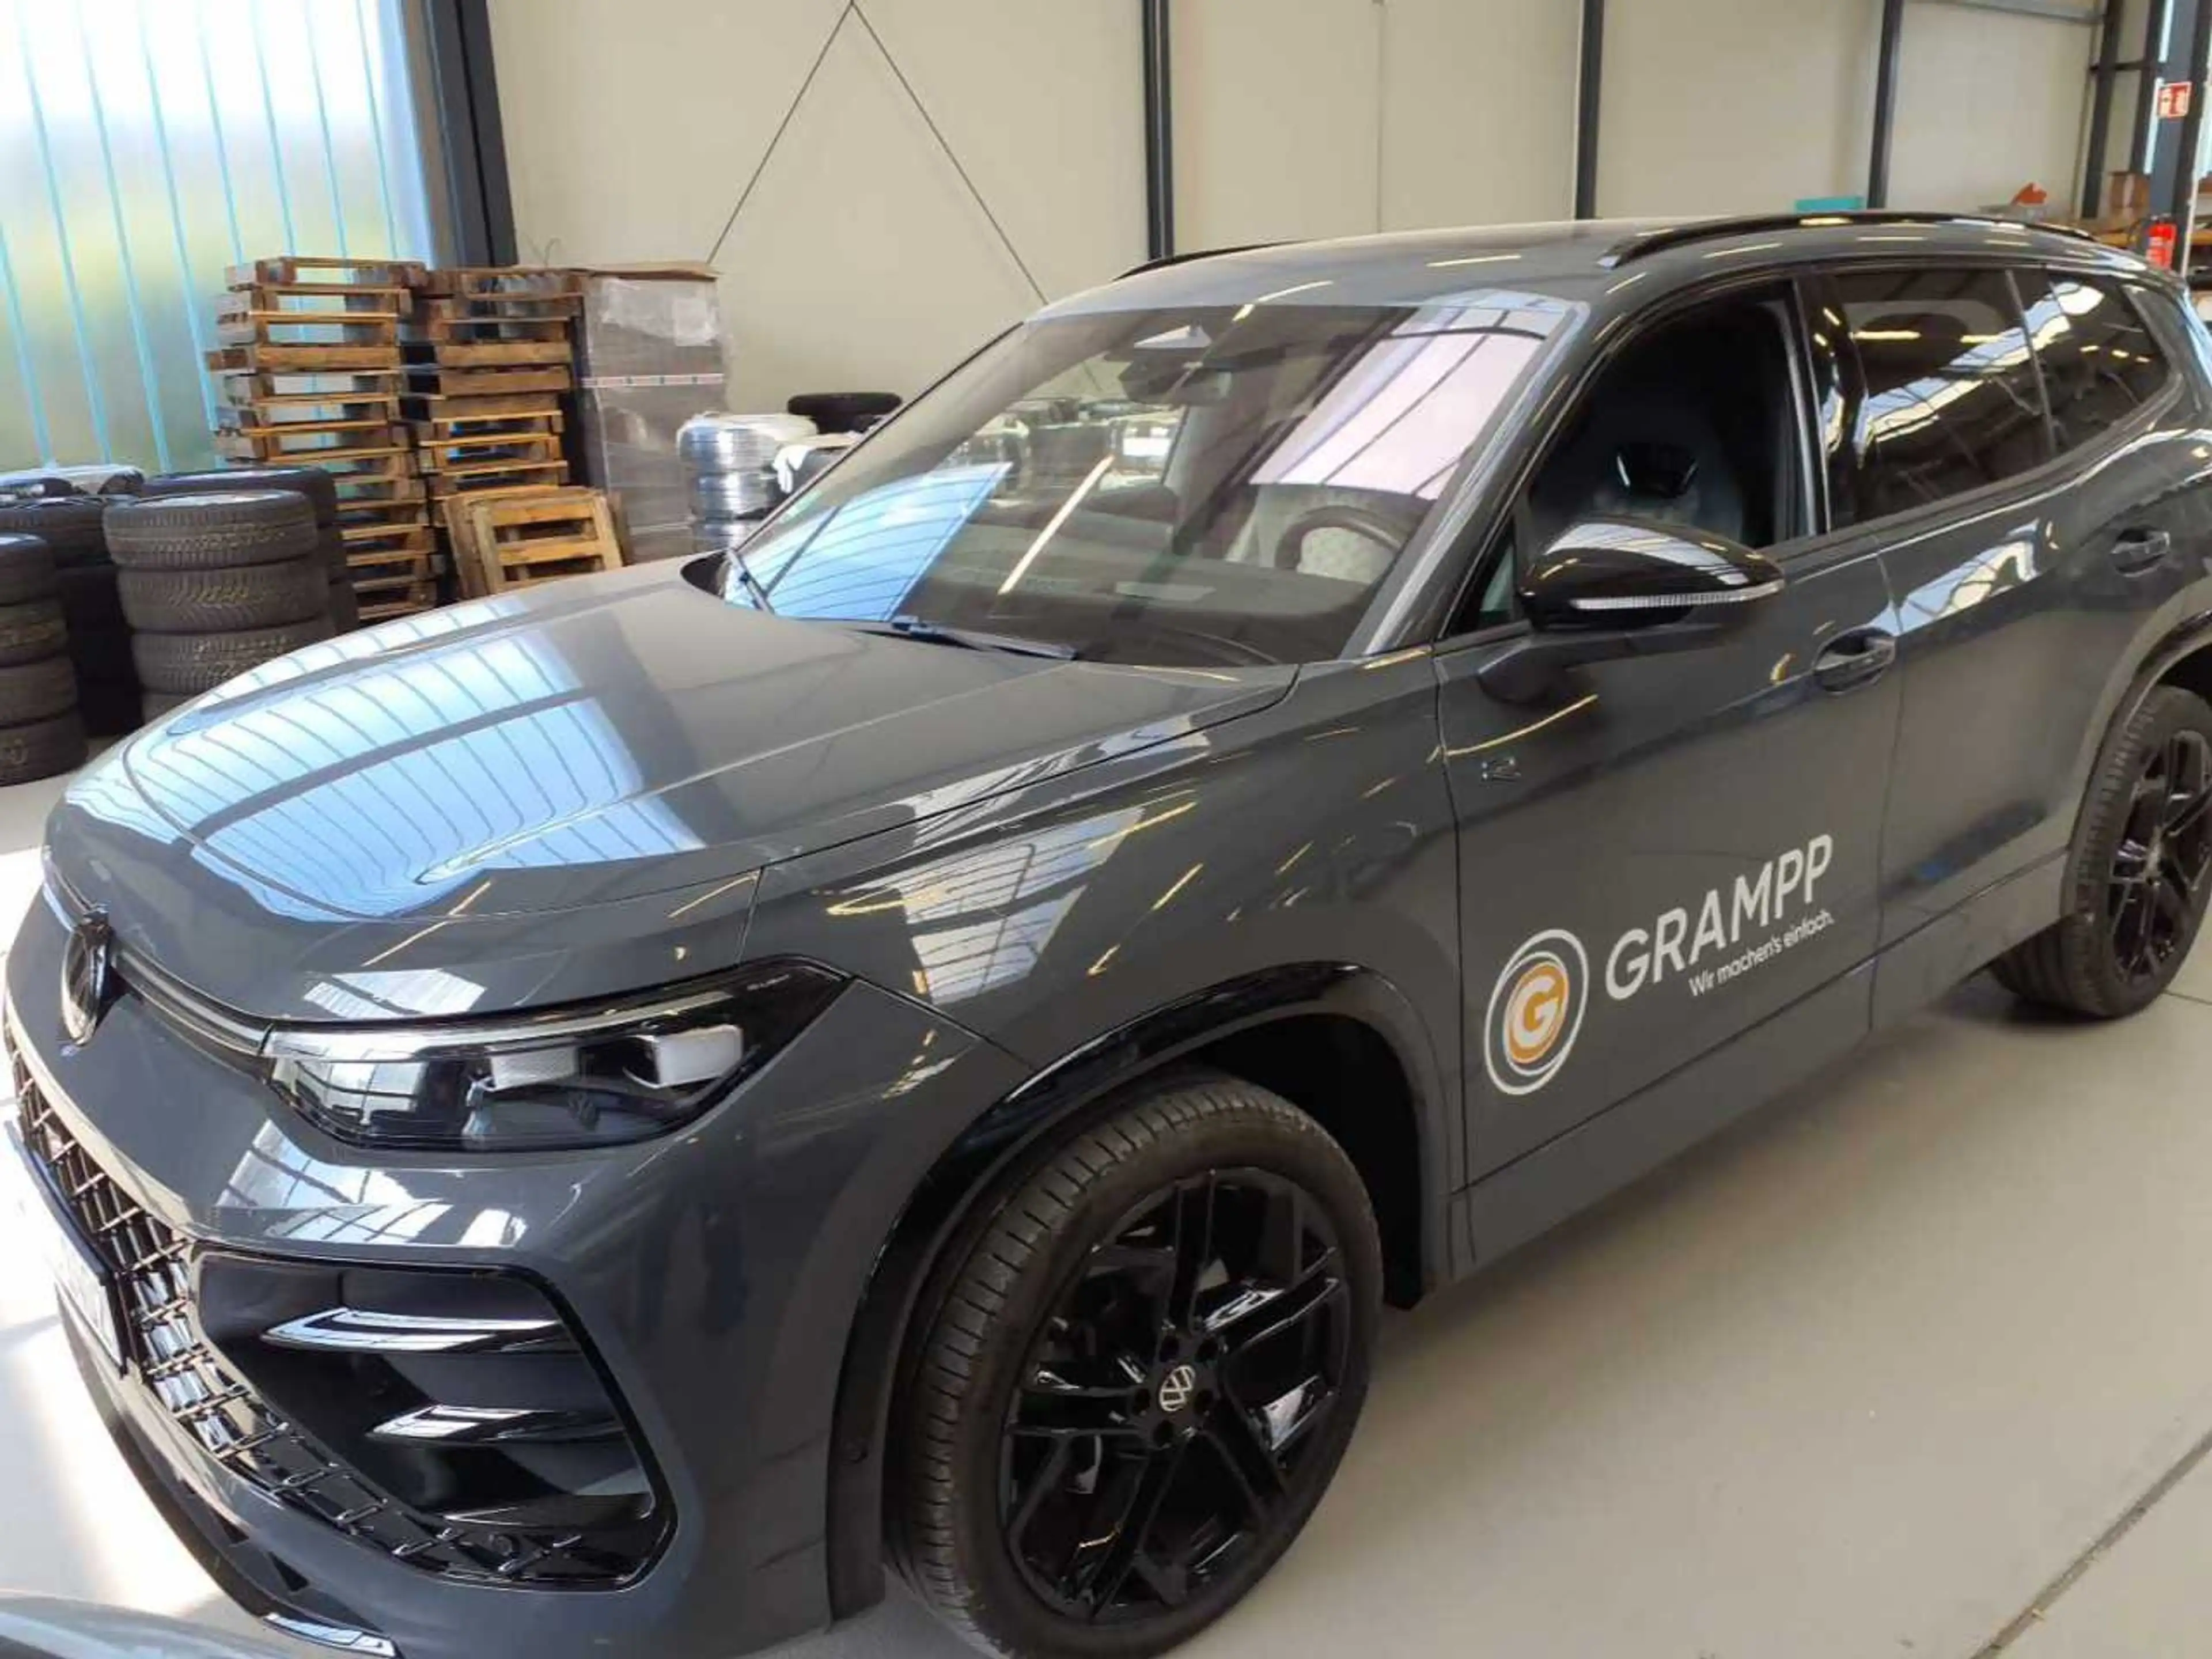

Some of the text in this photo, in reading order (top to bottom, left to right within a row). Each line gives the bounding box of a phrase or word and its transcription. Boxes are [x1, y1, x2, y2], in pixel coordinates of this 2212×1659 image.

[1605, 834, 1833, 1000] GRAMPP
[1688, 968, 1714, 996] Wir
[1717, 935, 1783, 984] machen's
[1512, 975, 1559, 1048] G
